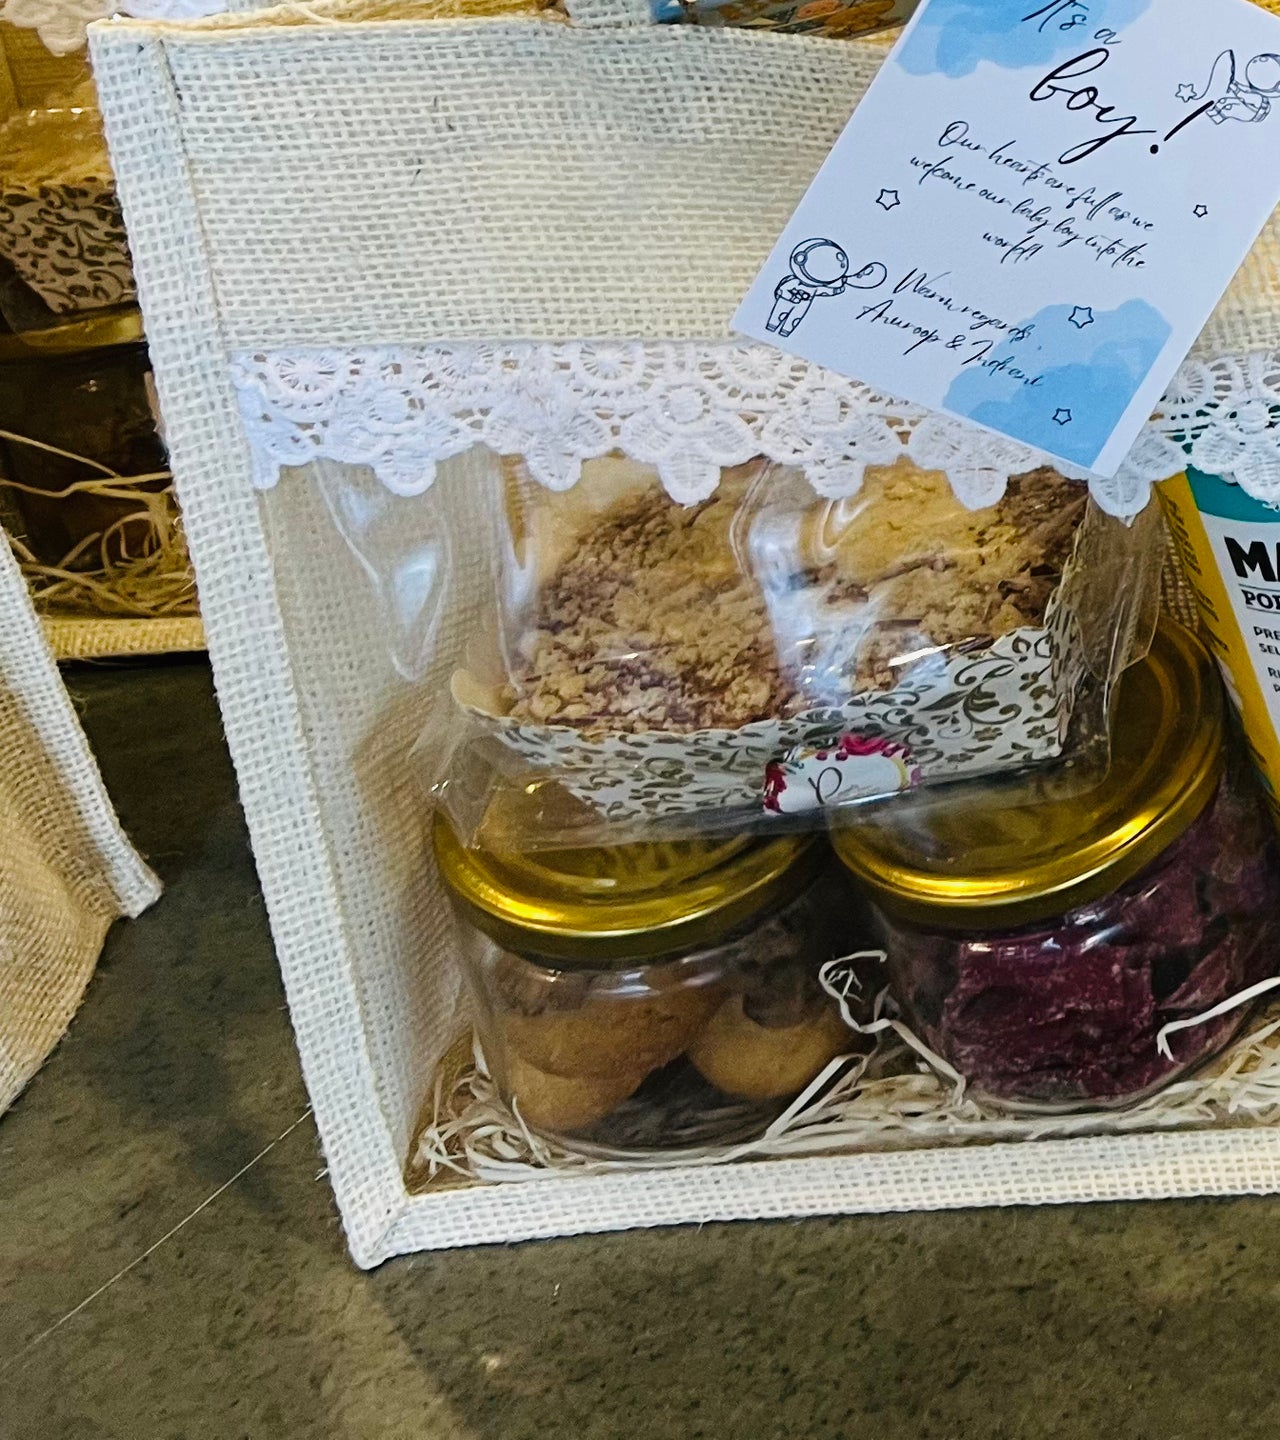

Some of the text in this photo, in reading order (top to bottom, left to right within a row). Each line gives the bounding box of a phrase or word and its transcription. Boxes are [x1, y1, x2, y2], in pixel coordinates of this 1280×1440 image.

[1093, 28, 1122, 45] a
[1029, 48, 1214, 164] boy!
[910, 156, 1149, 268] welcome our baby boy into the
[938, 121, 987, 153] Our
[989, 140, 1052, 185] hearts
[1044, 177, 1076, 195] are
[1066, 187, 1122, 221] full
[1132, 217, 1154, 232] we
[893, 268, 959, 311] Warm
[945, 334, 966, 351] &
